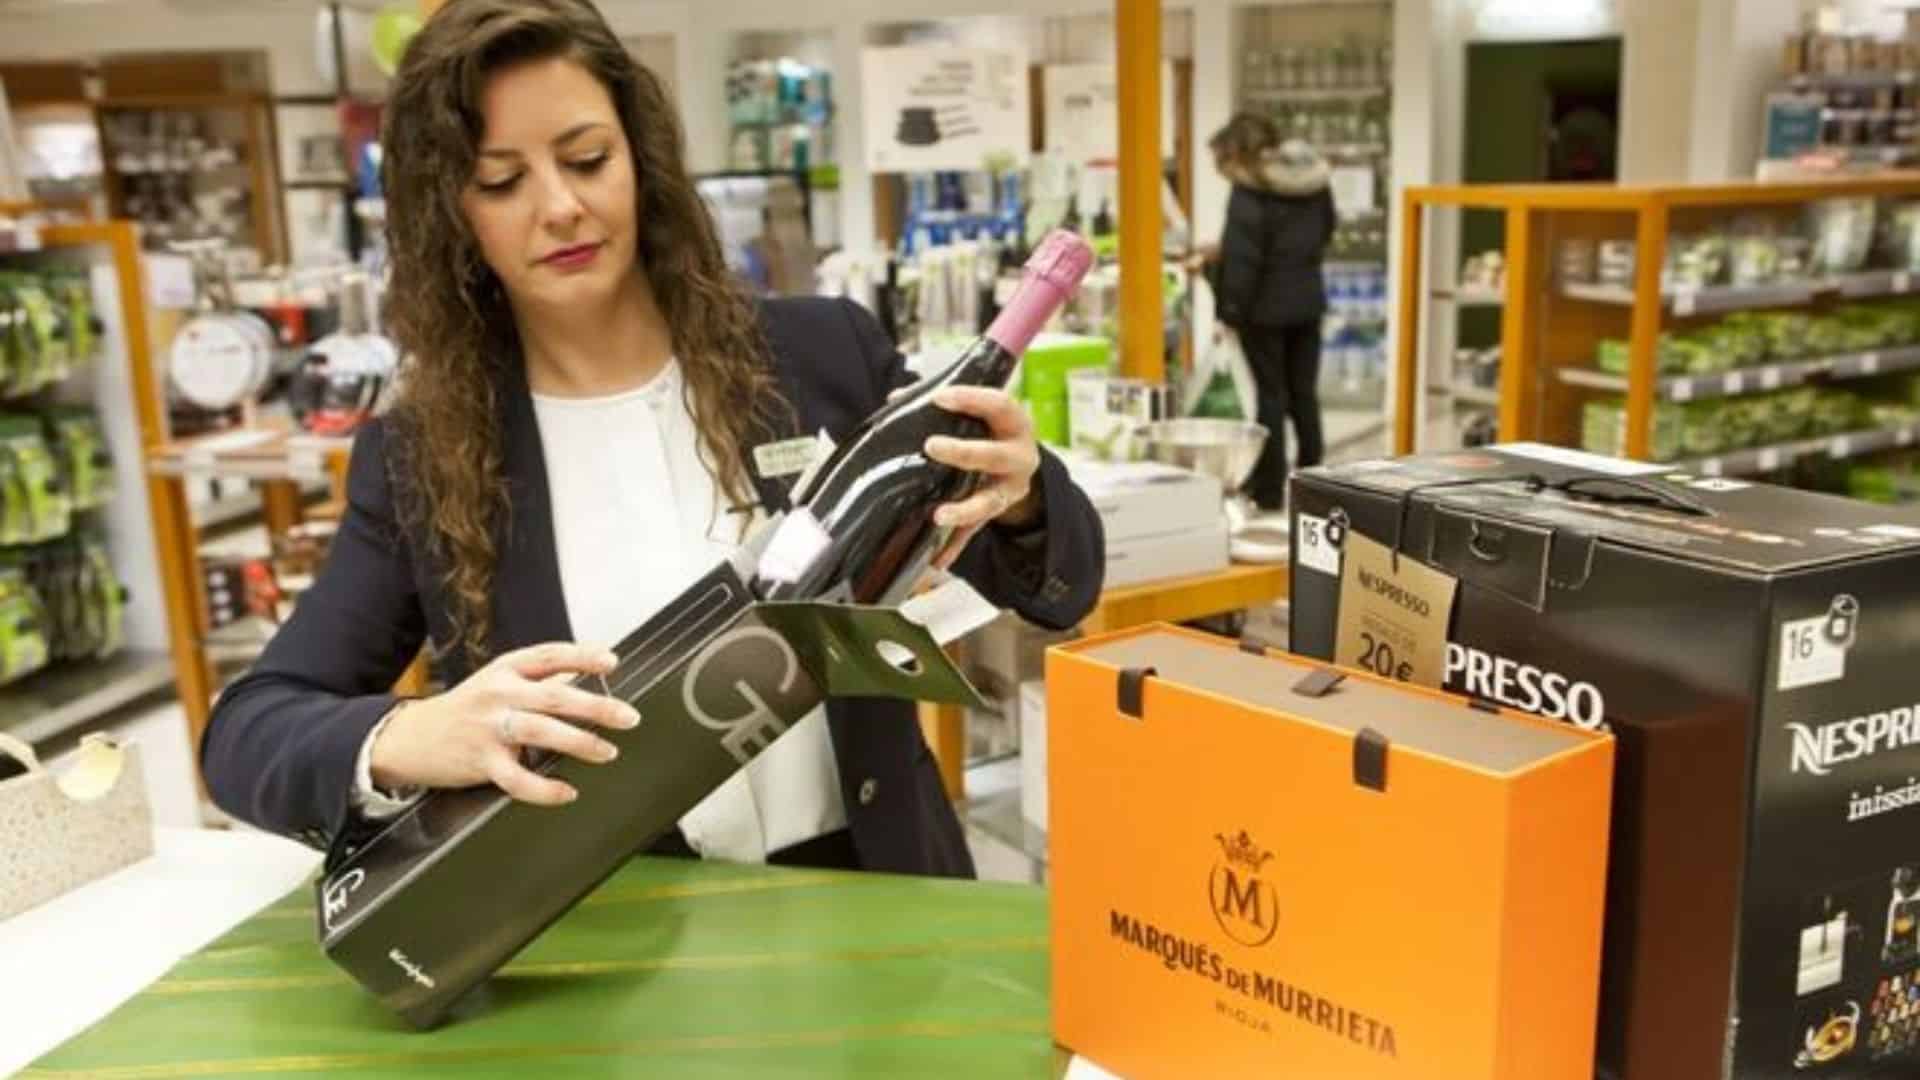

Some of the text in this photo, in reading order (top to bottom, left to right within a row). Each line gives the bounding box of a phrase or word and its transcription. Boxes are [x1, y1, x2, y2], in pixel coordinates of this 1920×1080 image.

[1357, 631, 1414, 682] 20€
[1789, 626, 1813, 660] 16
[1444, 641, 1604, 731] PRESSO
[1221, 866, 1265, 928] M
[1110, 908, 1397, 1056] MARQUÉS DE MURRIETA
